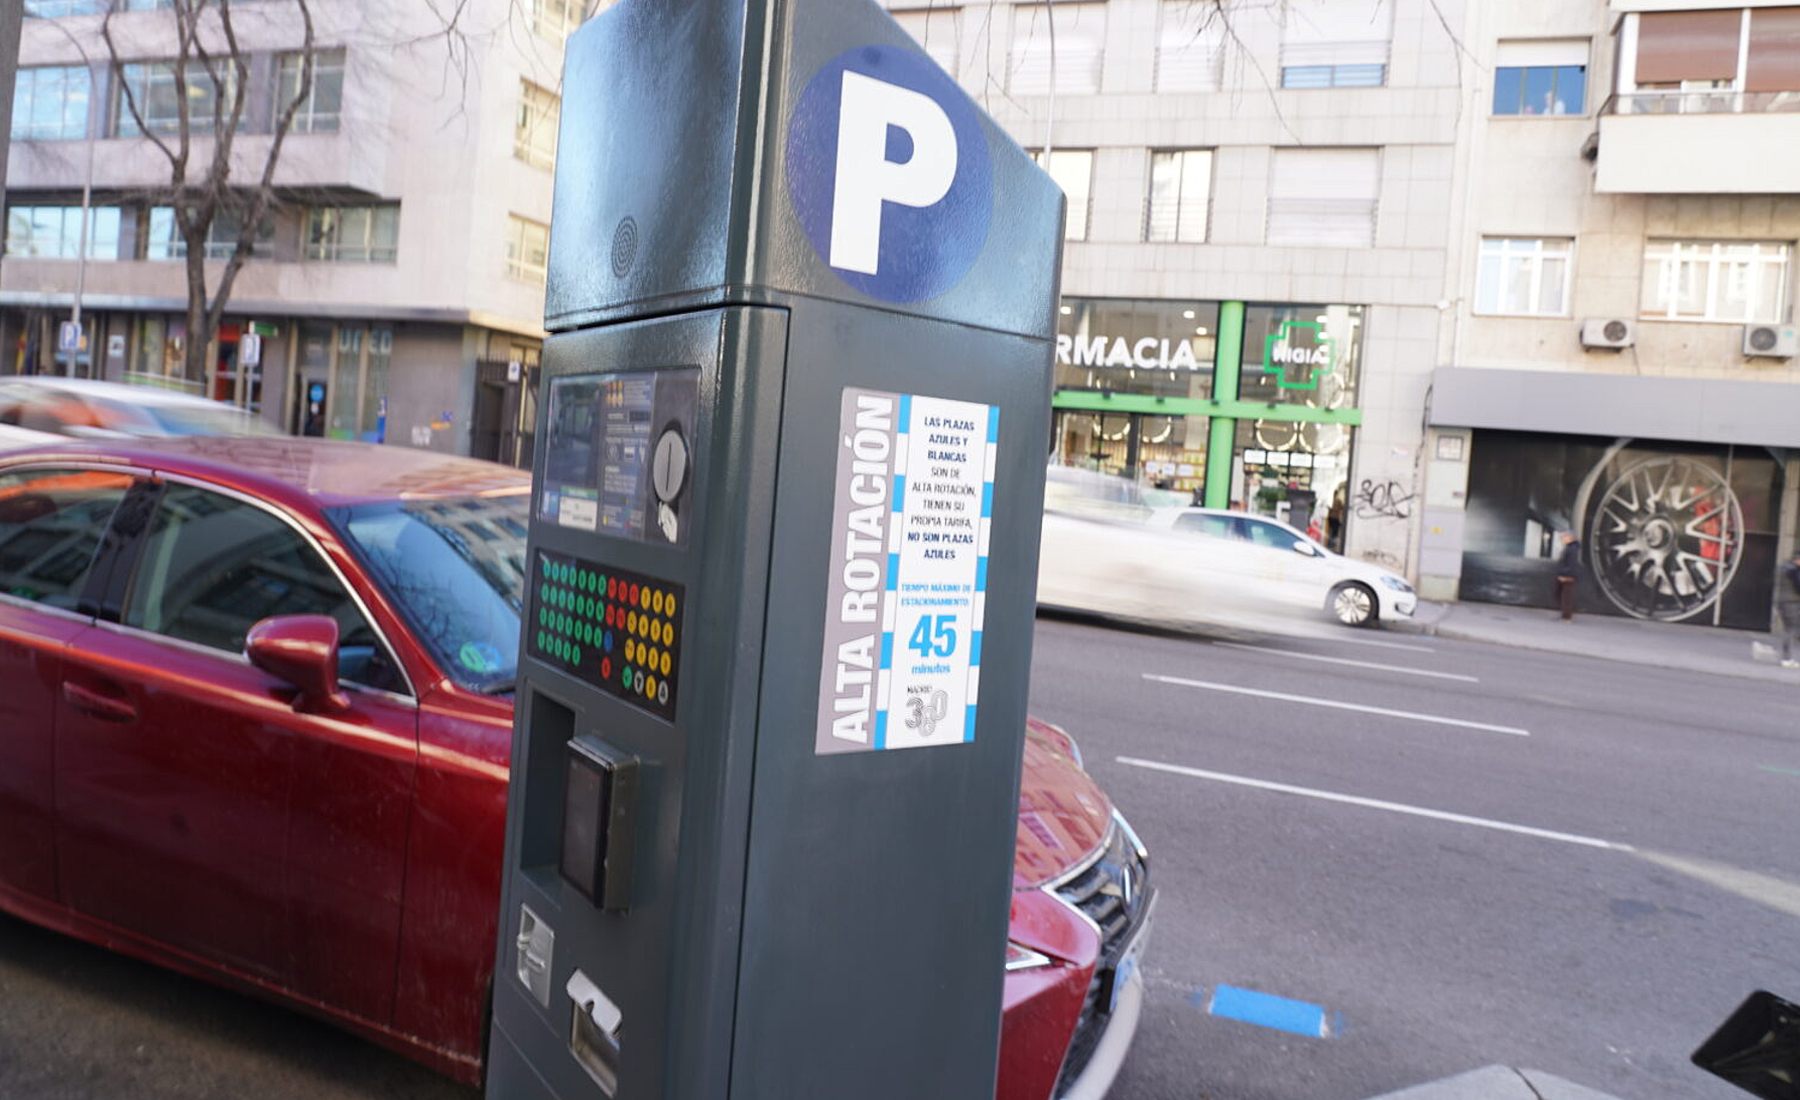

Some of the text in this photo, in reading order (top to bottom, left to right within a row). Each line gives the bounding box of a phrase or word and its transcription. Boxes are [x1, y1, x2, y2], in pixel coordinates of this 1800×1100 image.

[830, 69, 958, 275] P
[1055, 334, 1198, 371] RMACIA
[924, 416, 975, 431] LAS PLAZAS
[929, 434, 969, 446] AZULES Y
[928, 450, 967, 462] BLANCAS
[931, 466, 961, 479] SON DE
[912, 482, 932, 492] ALTA
[923, 499, 965, 511] TIENEN SU
[911, 515, 942, 526] PROPIA
[907, 531, 974, 544] NO SON PLAZAS
[924, 549, 956, 559] AZULES
[832, 395, 894, 744] ALTA ROTACIÓN
[902, 583, 929, 592] TIEMPO
[908, 614, 957, 658] 45
[912, 663, 951, 674] minutos
